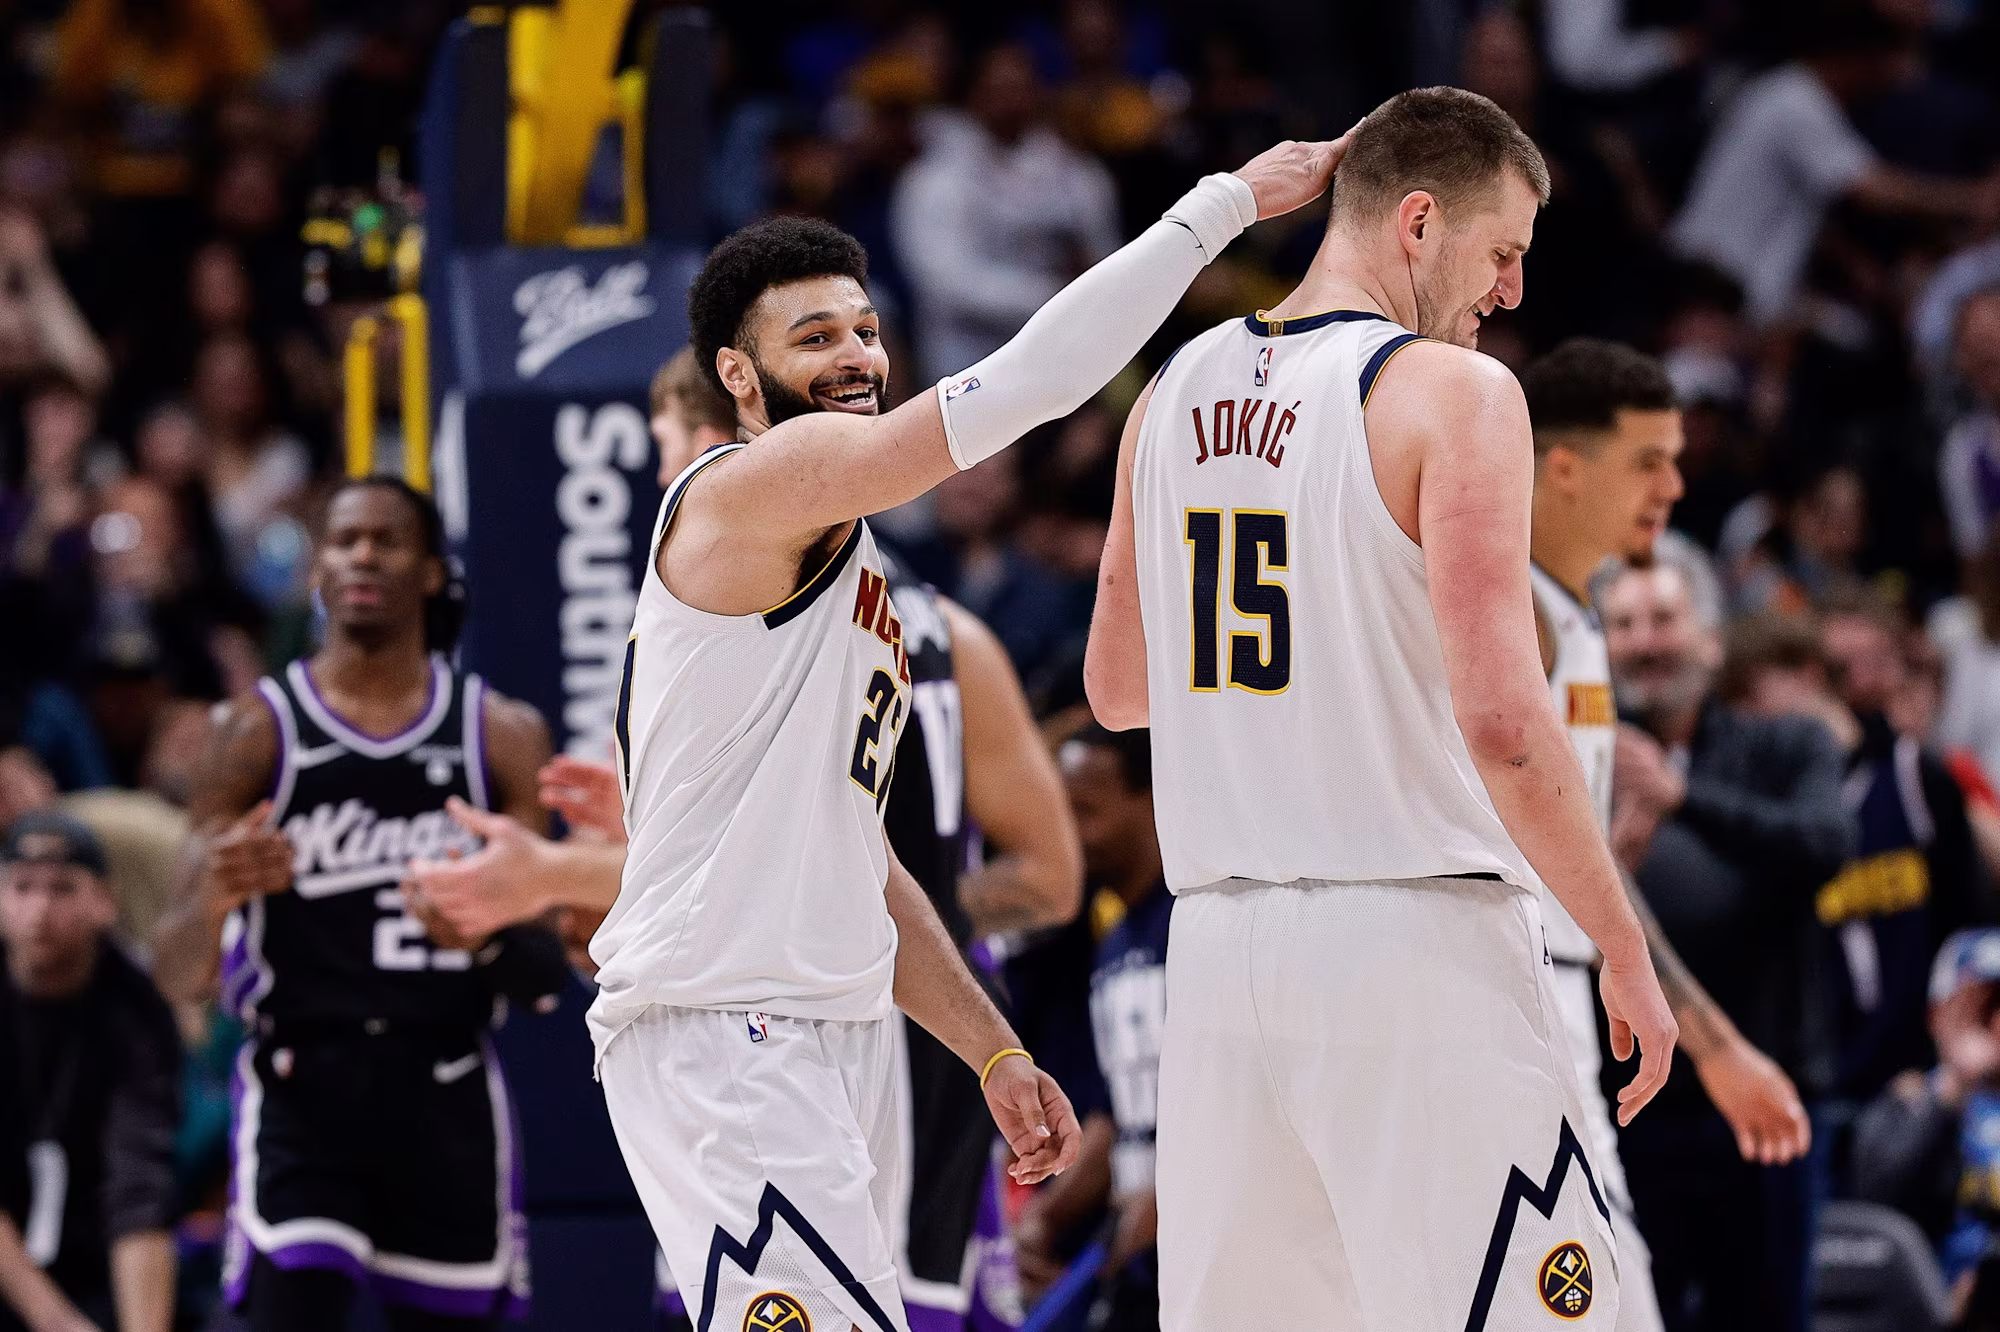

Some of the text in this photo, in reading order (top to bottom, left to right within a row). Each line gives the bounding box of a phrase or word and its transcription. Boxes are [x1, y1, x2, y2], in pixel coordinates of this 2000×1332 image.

[1192, 398, 1301, 468] JOKIĆ
[1183, 507, 1291, 696] 15
[373, 888, 472, 972] 2
